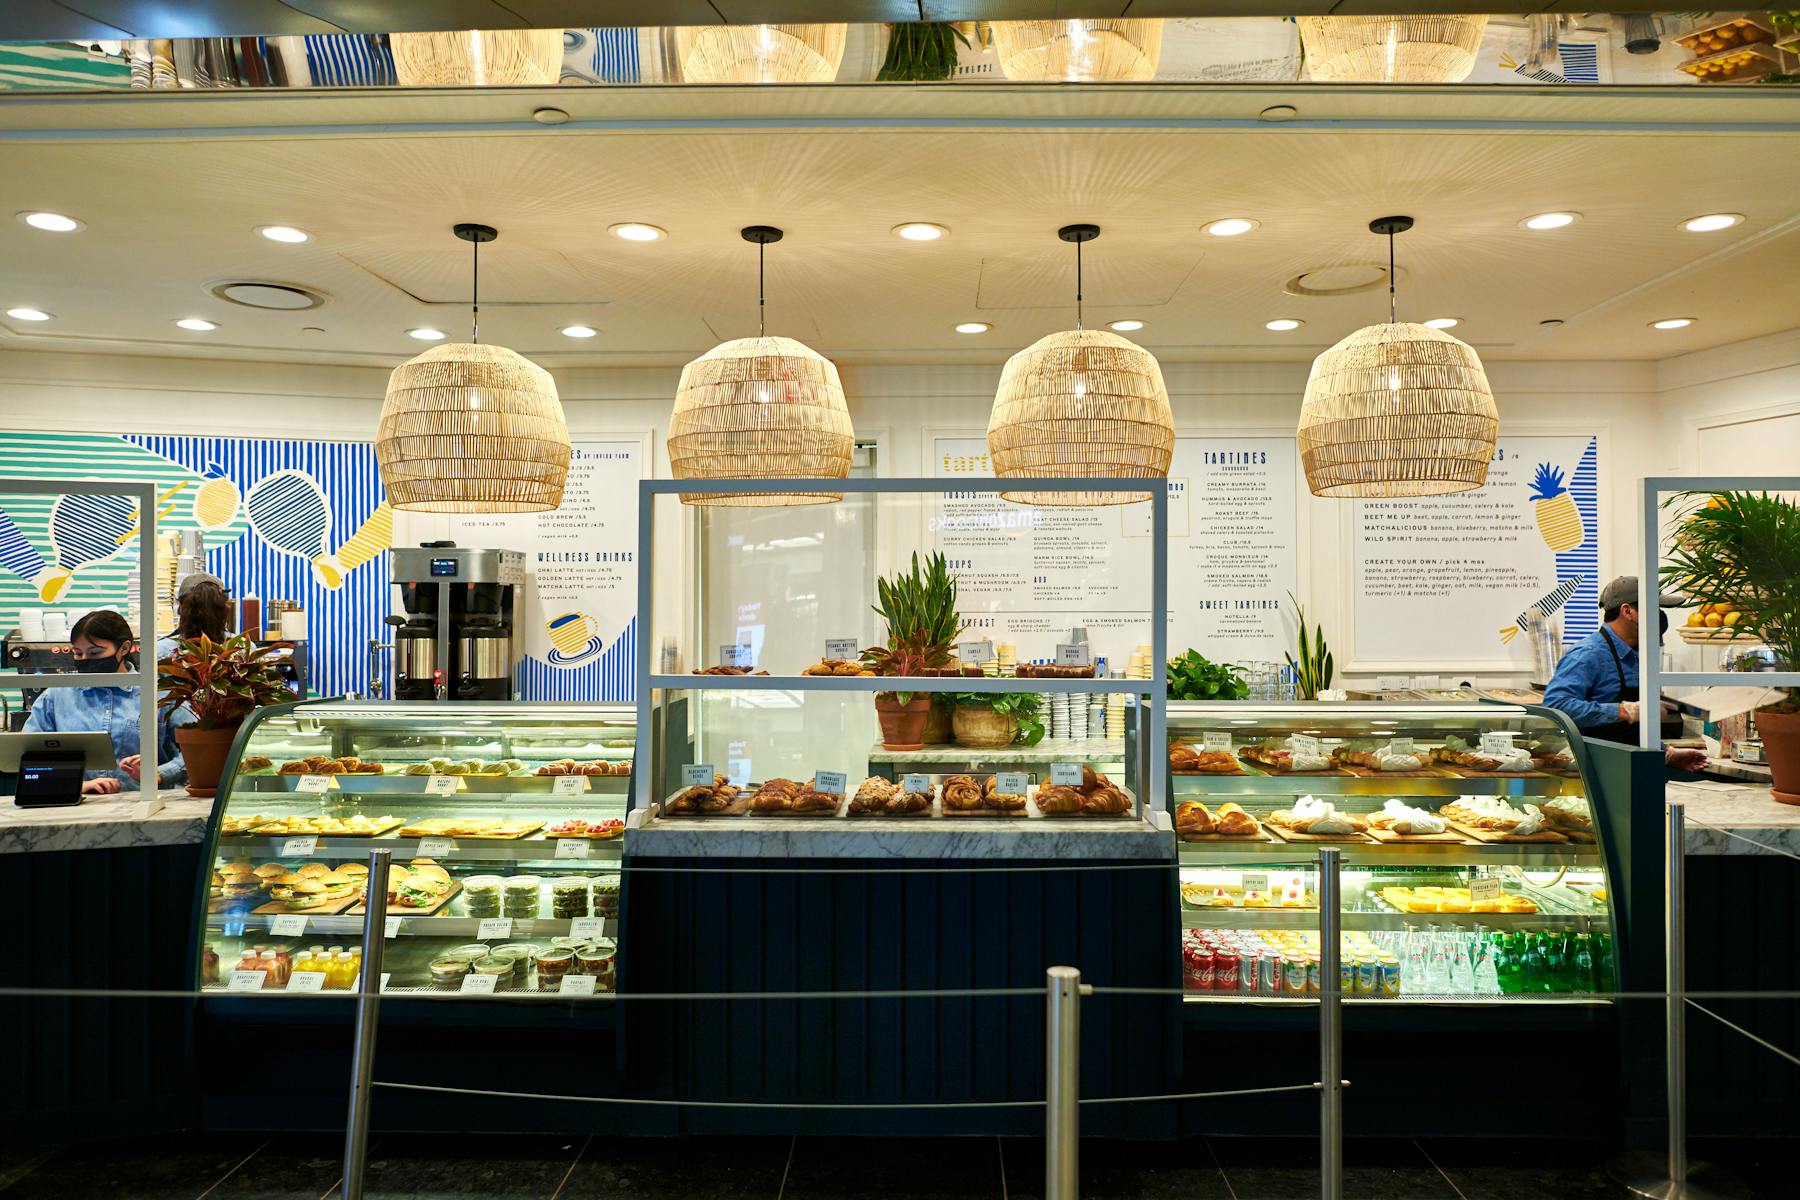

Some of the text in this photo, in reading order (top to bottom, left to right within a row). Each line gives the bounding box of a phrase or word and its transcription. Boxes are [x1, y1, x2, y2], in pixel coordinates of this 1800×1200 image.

[1204, 451, 1267, 465] TARTINES
[537, 552, 633, 563] WELLNESS DRINKS
[1199, 600, 1279, 610] SWEET TARTINES
